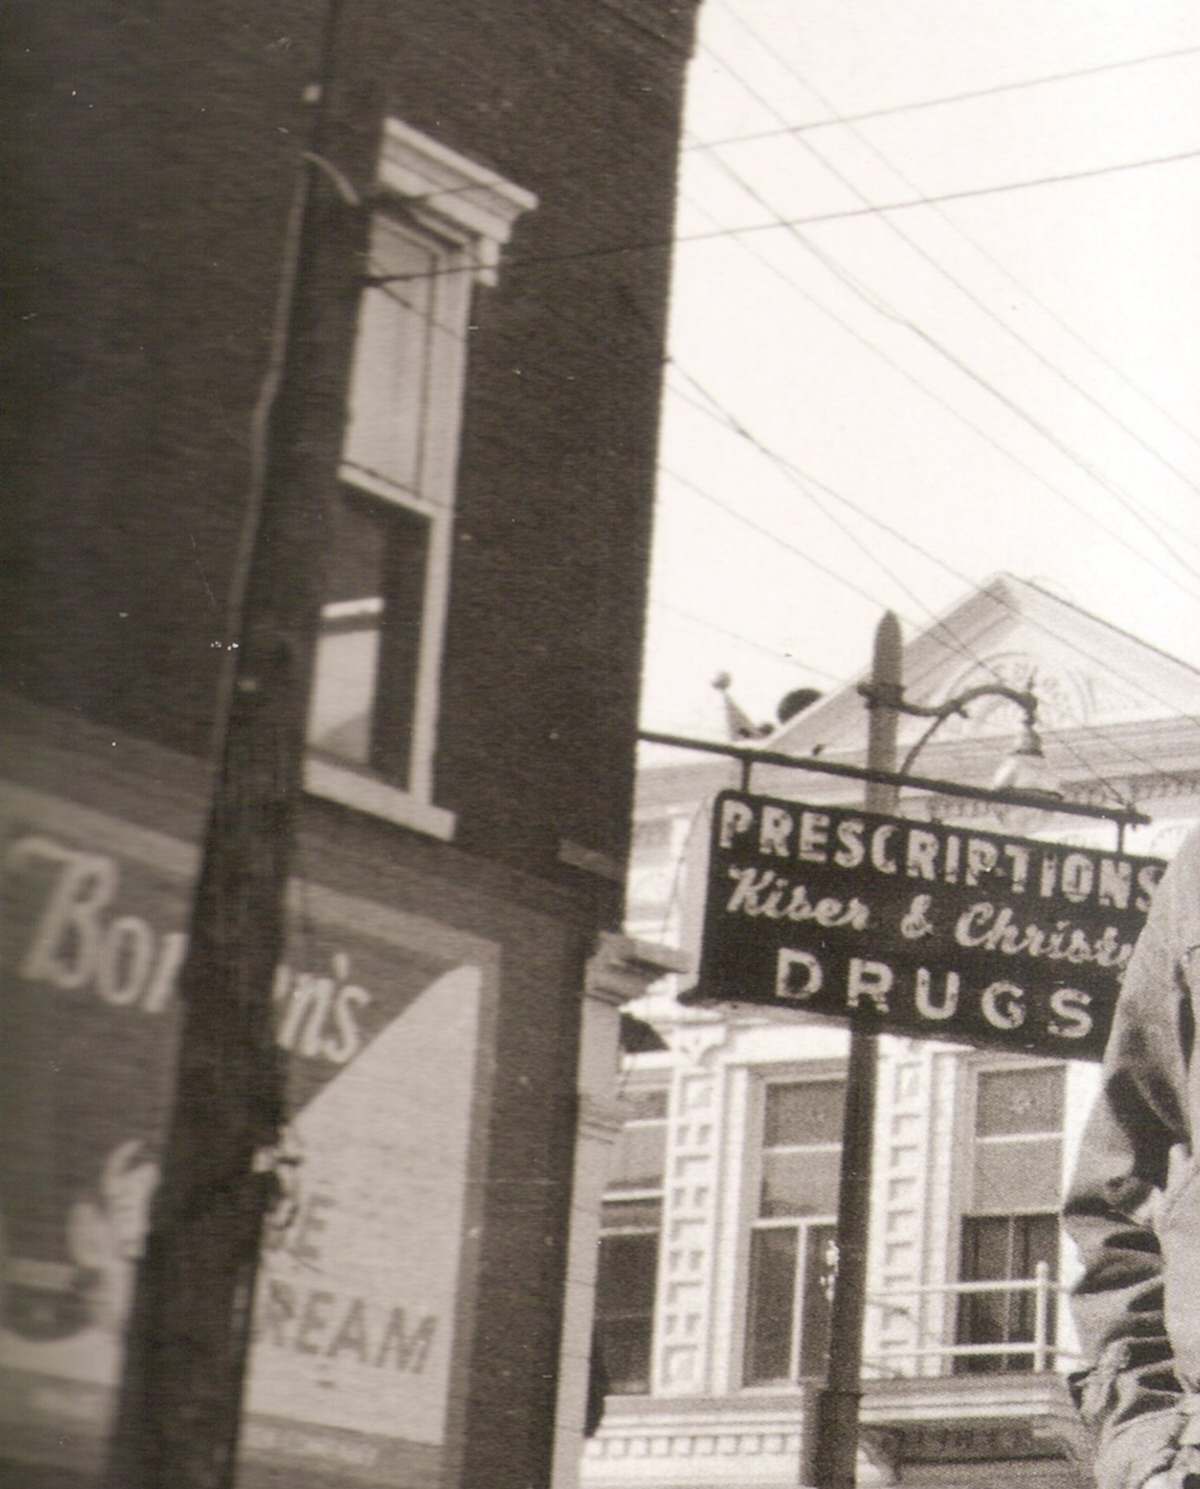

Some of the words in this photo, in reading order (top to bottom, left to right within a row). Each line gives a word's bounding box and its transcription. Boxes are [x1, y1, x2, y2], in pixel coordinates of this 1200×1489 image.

[718, 799, 1162, 912] PRESCRIPTIONS
[726, 865, 870, 931] Kiser
[900, 894, 934, 939] &
[775, 947, 1094, 1038] DRUGS
[258, 1279, 439, 1375] REAM
